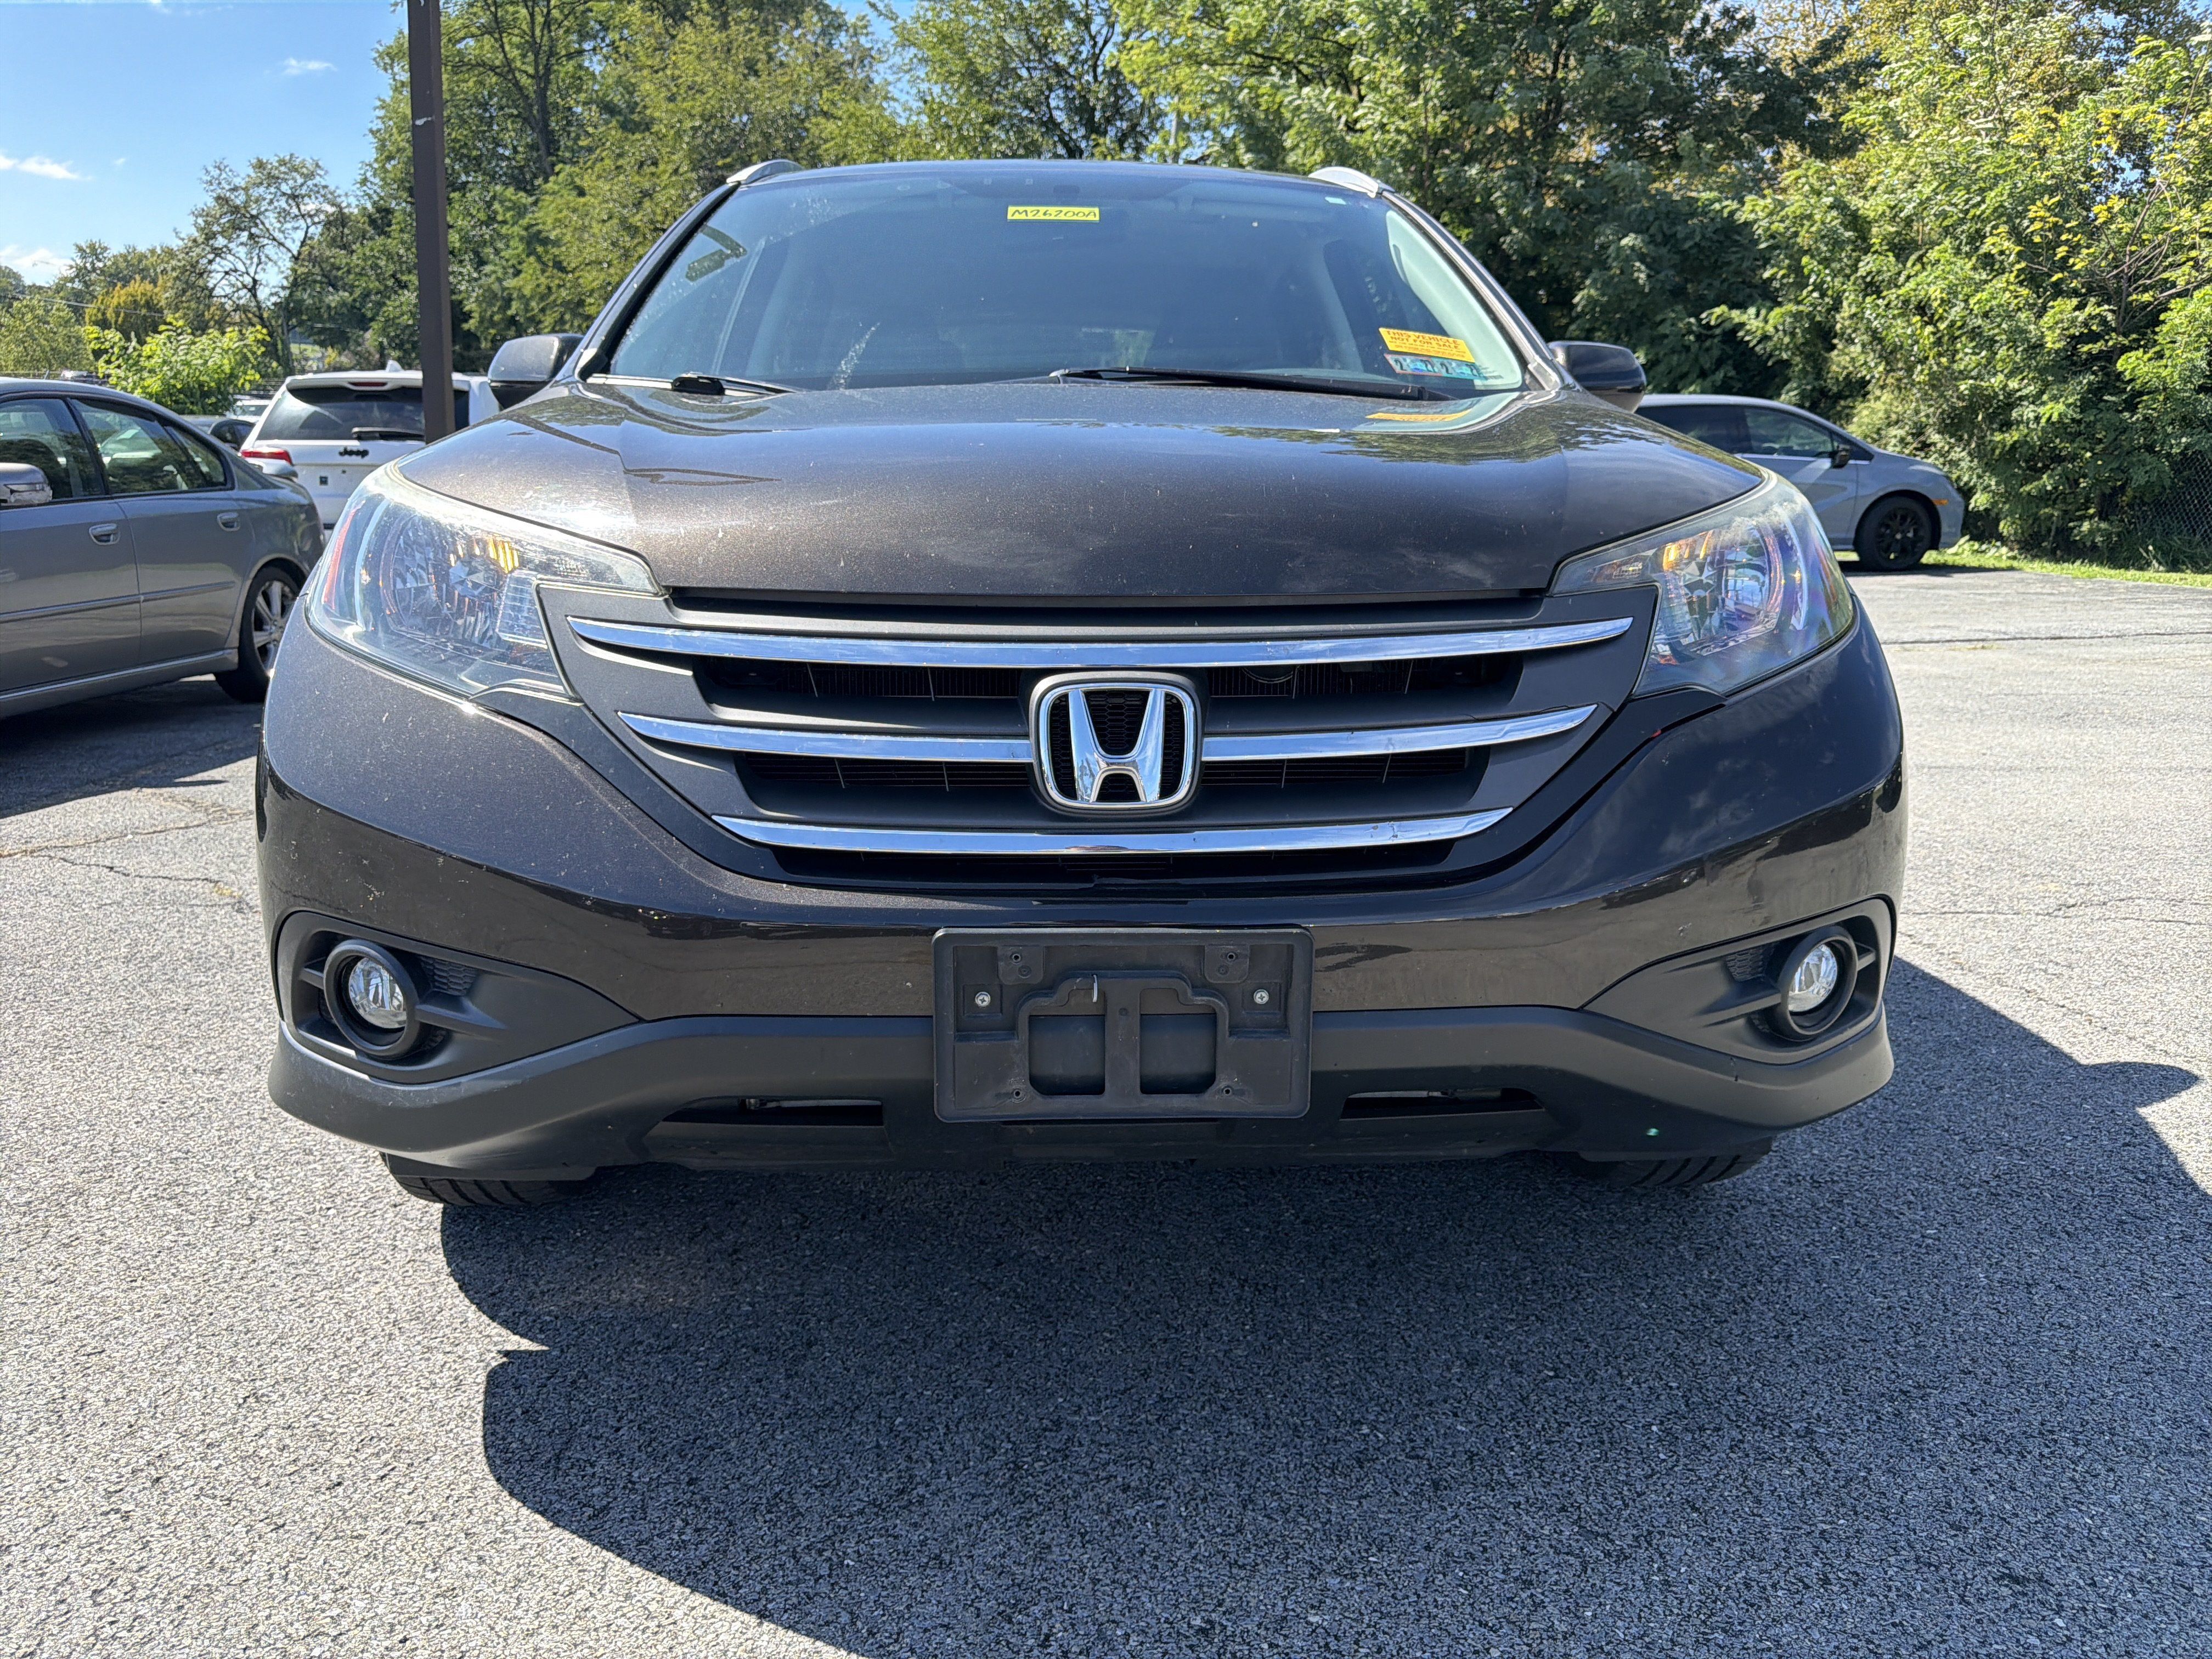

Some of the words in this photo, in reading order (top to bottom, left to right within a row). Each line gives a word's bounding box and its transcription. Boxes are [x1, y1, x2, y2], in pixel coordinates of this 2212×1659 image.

[1011, 209, 1097, 218] M26200A
[1413, 334, 1460, 346] VEHICLE
[338, 447, 369, 459] Jeep
